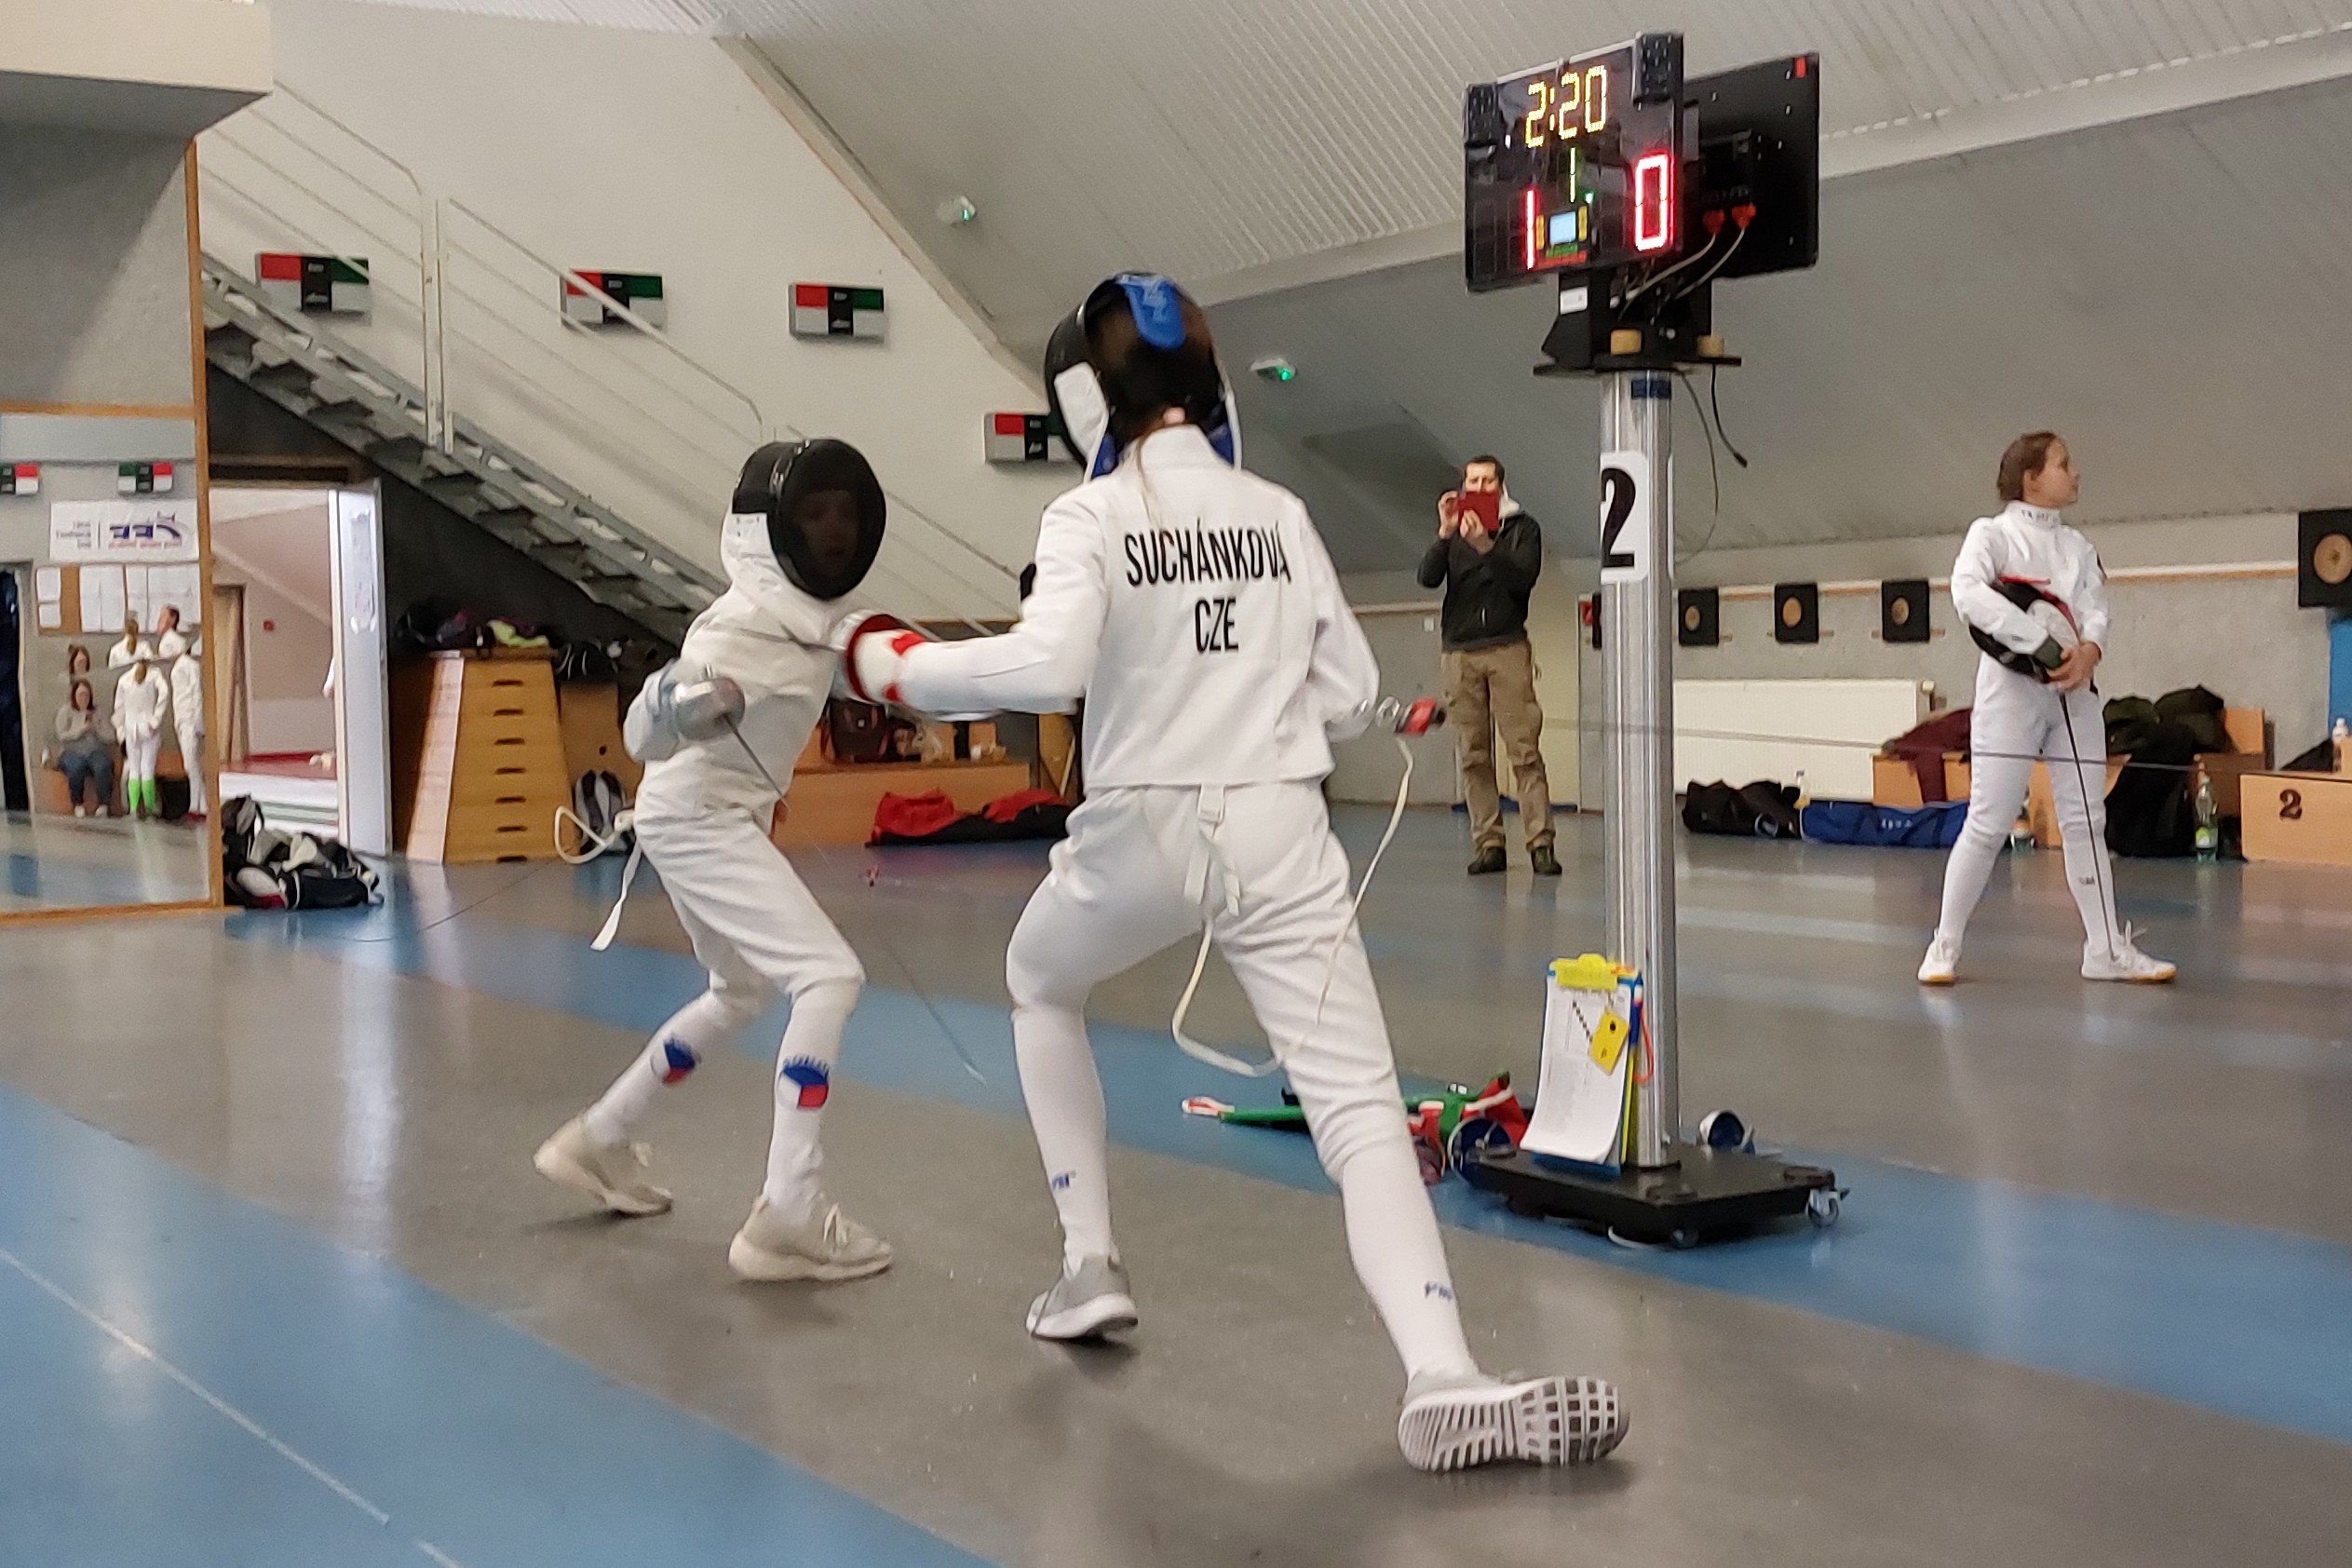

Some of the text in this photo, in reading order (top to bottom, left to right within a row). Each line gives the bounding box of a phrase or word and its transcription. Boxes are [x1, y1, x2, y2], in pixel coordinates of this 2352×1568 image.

[1525, 65, 1607, 147] 2:20
[1525, 189, 1536, 270] 1
[1635, 154, 1669, 251] 0
[1124, 517, 1291, 588] SUCHÁNKOVÁ
[1602, 467, 1637, 567] 2
[1195, 597, 1239, 654] CZE
[2278, 789, 2303, 820] 2
